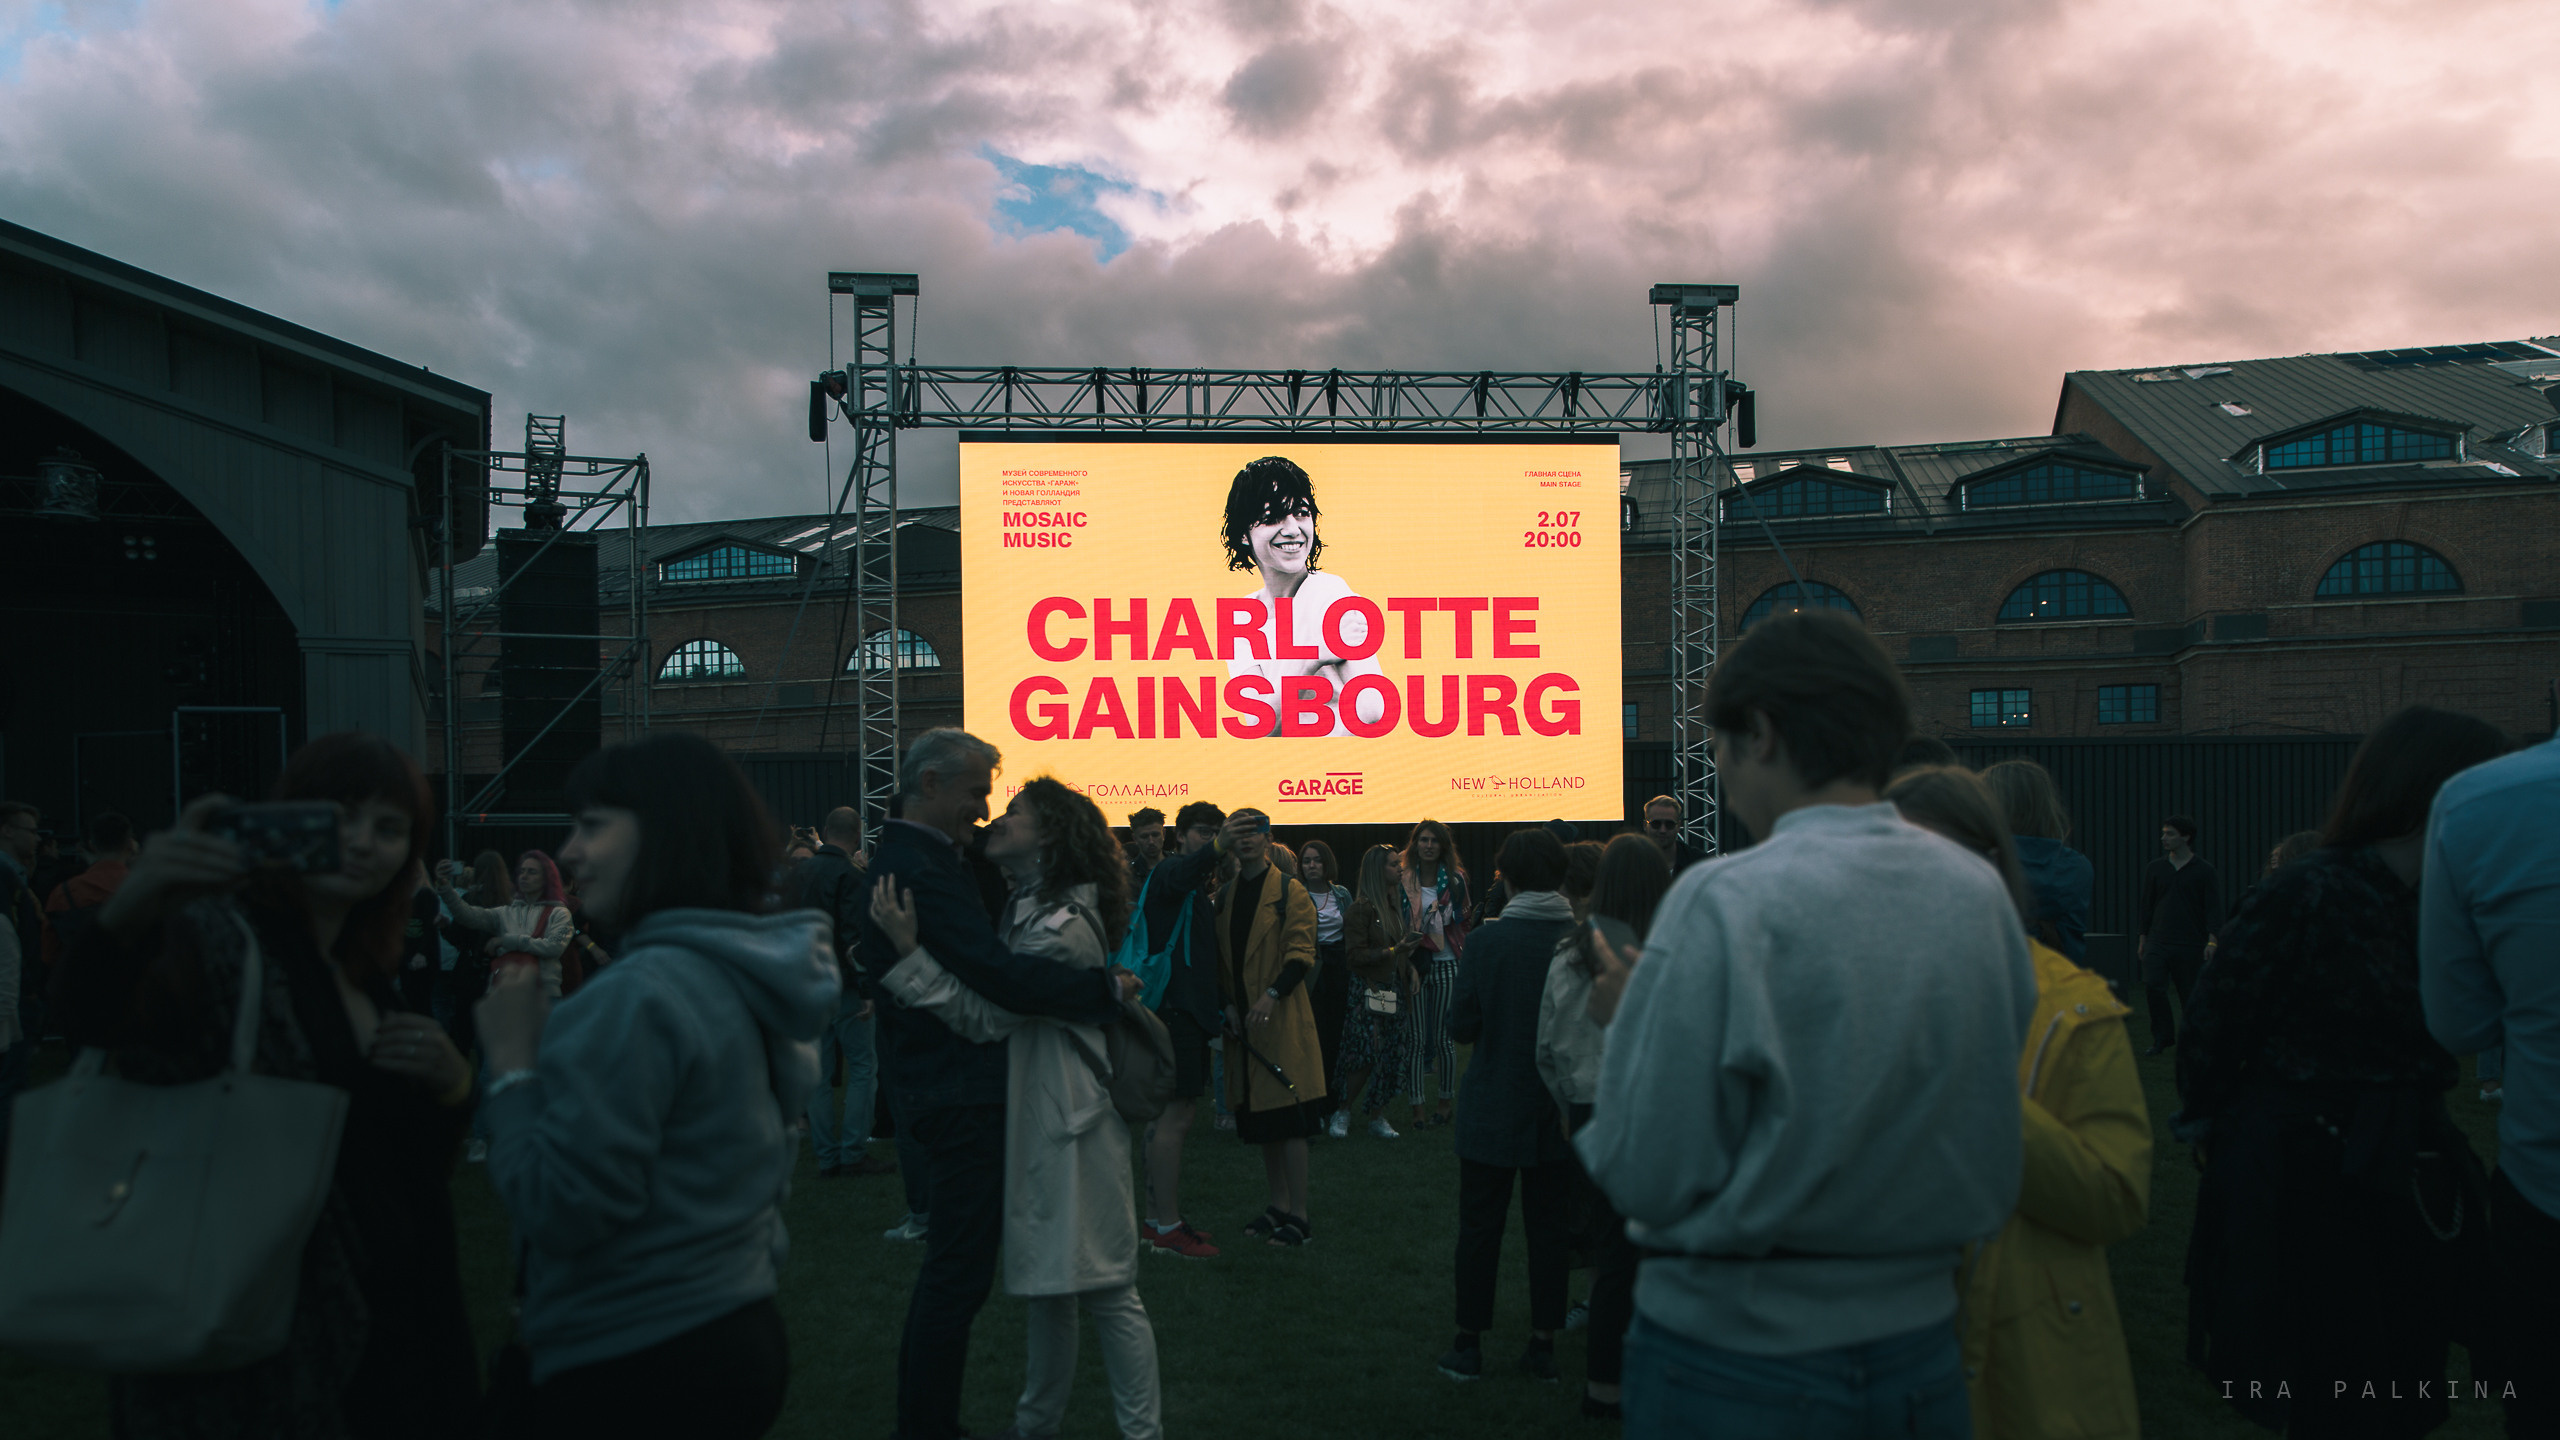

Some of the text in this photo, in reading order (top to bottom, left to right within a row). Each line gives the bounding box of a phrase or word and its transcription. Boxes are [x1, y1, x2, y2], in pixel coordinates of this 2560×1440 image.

[1002, 469, 1027, 477] МУЗЕЙ
[1003, 512, 1088, 528] MOSAIC
[1537, 511, 1581, 528] 2.07
[1003, 532, 1072, 549] MUSIC
[1524, 531, 1582, 548] 20:00
[1026, 596, 1541, 662] CHARLOTTE
[1009, 672, 1581, 742] GAINSBOURG
[1088, 783, 1189, 798] ГОЛЛАНДИЯ
[1278, 778, 1363, 796] GARAGE
[1451, 776, 1585, 790] NEW HOLLAND
